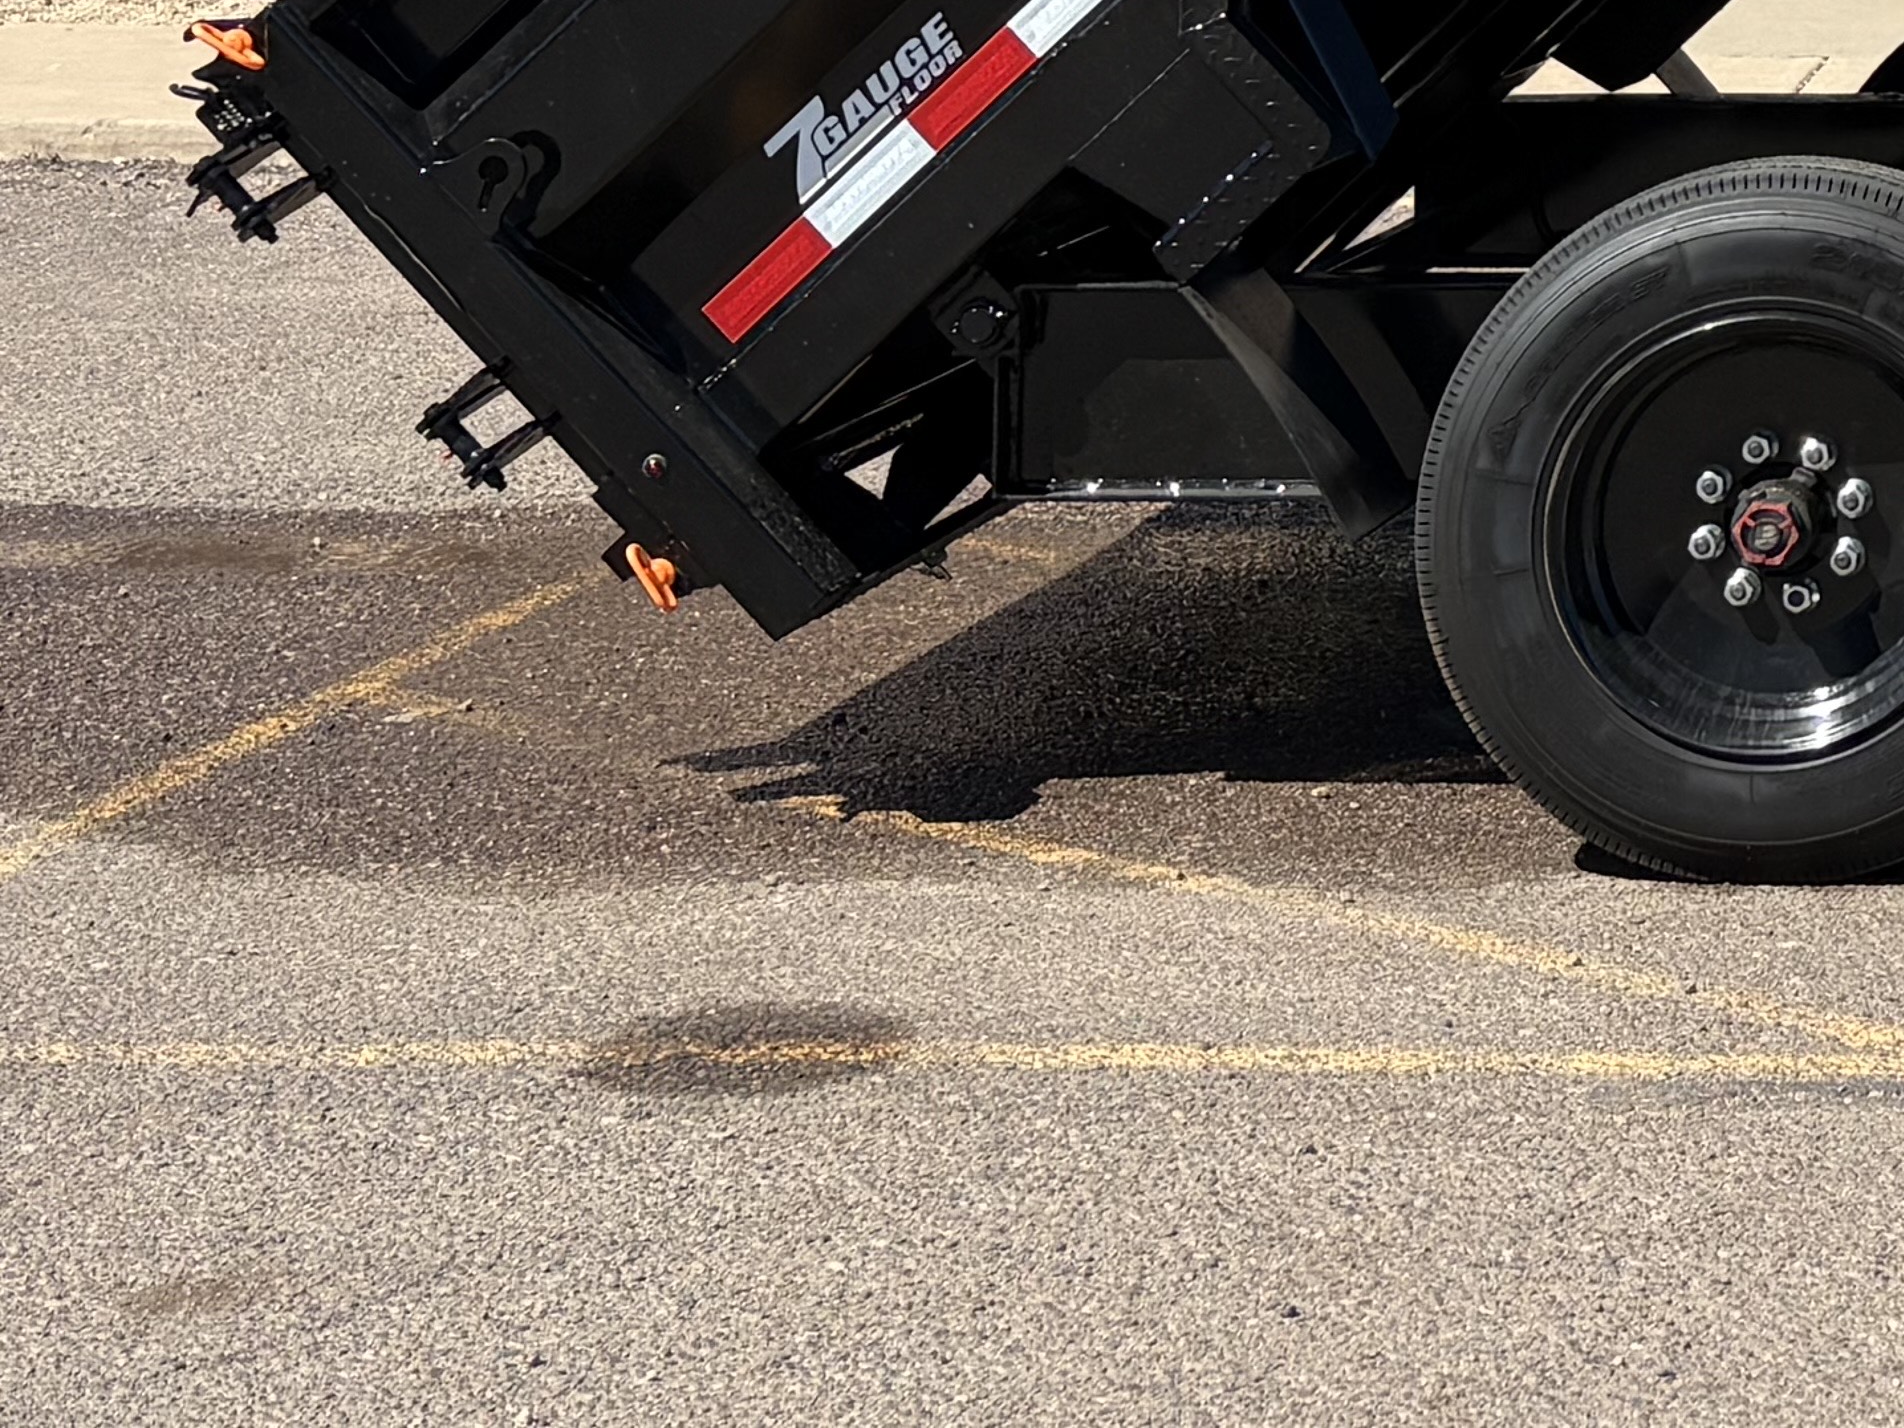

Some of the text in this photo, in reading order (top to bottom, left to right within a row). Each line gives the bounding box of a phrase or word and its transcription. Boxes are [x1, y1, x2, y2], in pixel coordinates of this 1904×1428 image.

[763, 11, 955, 204] 7 GAUGE
[889, 40, 963, 116] FLOOR
